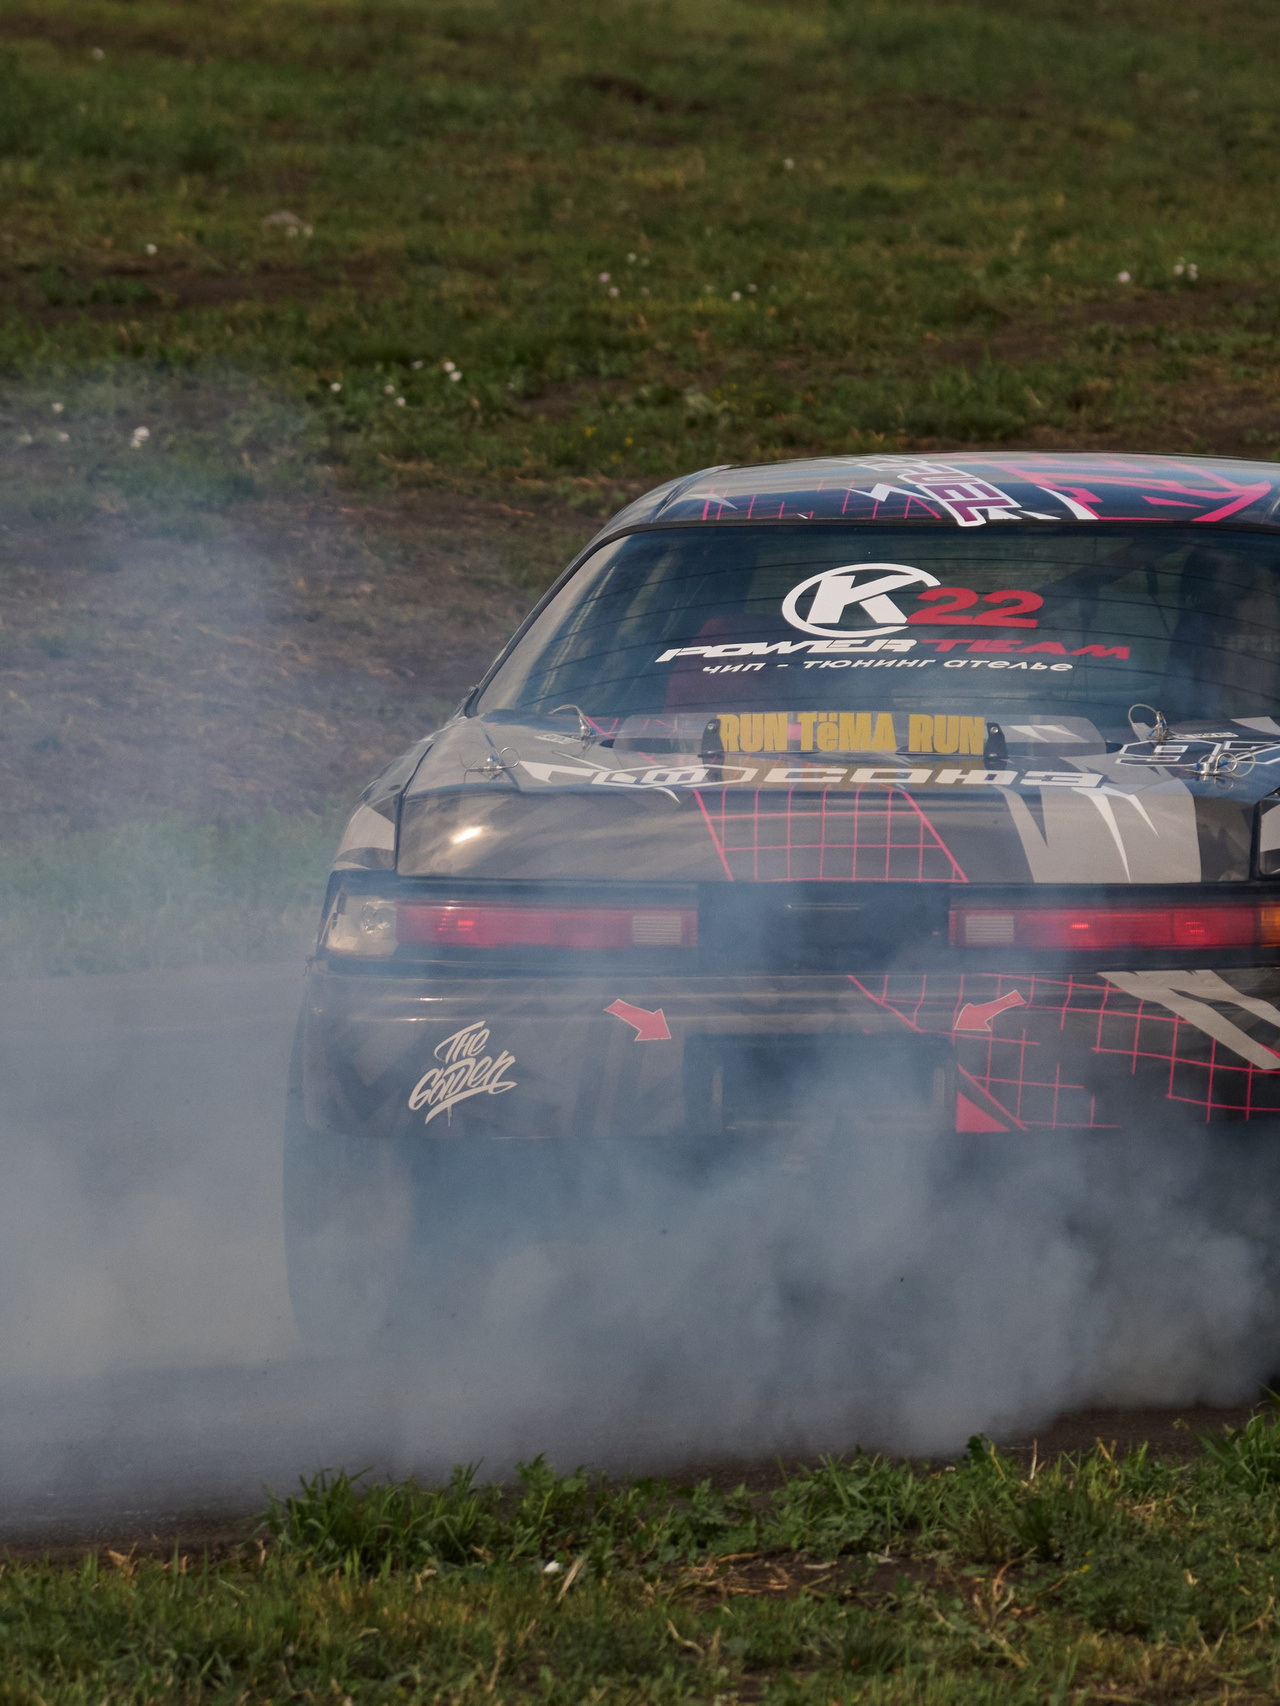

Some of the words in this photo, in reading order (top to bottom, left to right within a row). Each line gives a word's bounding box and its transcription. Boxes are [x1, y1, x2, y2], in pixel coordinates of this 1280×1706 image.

[782, 563, 1043, 637] K22
[655, 638, 918, 663] POWER
[921, 638, 1131, 661] TEAM
[718, 713, 788, 753] RUN
[908, 714, 985, 756] RUN
